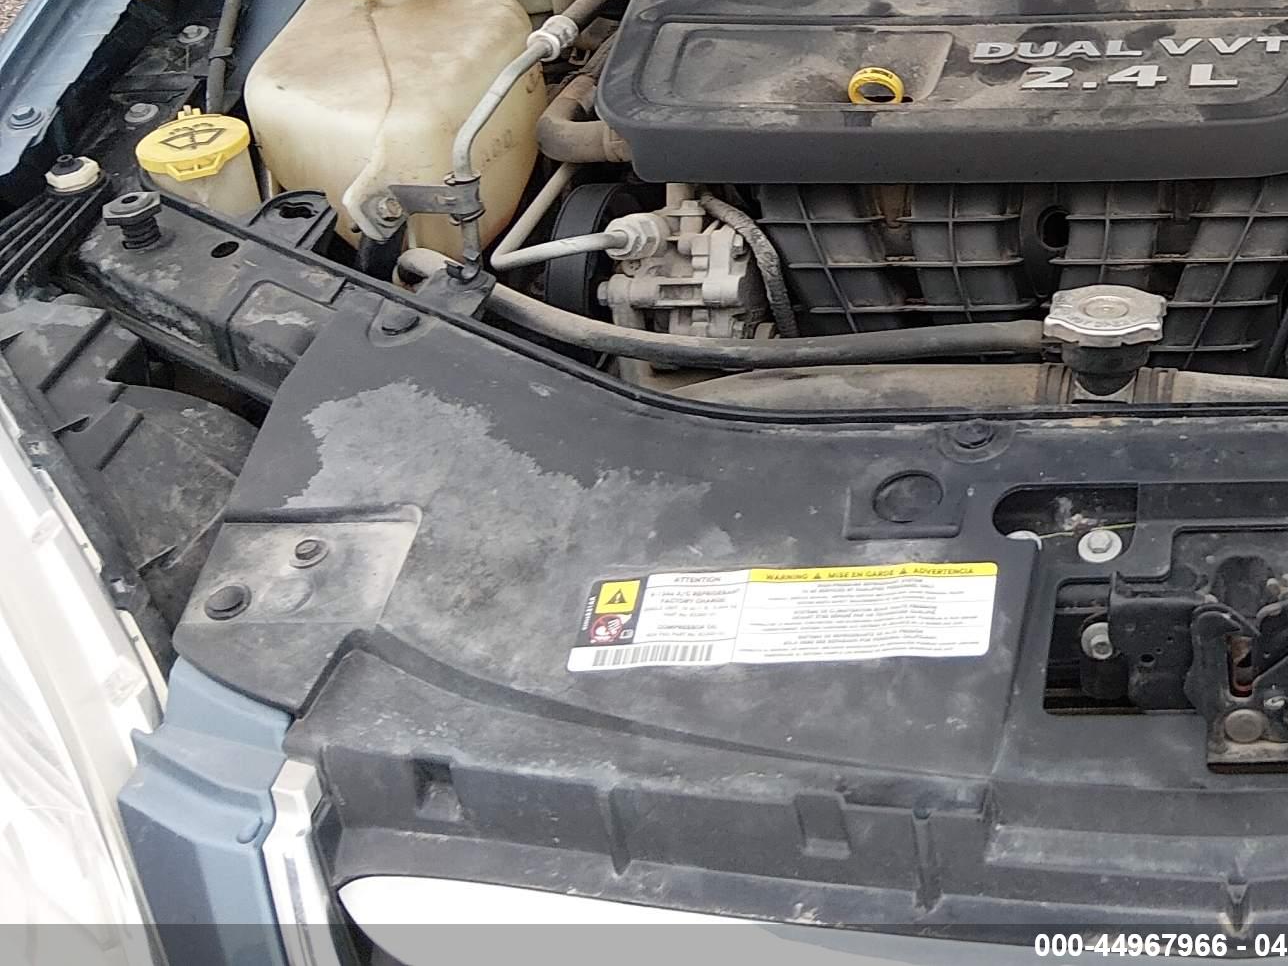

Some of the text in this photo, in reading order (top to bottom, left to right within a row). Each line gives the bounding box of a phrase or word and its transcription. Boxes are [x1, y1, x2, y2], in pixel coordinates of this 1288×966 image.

[973, 40, 1143, 60] DUAL
[1021, 64, 1168, 90] 2.4
[828, 571, 849, 579] MISE
[865, 569, 894, 577] GARDE
